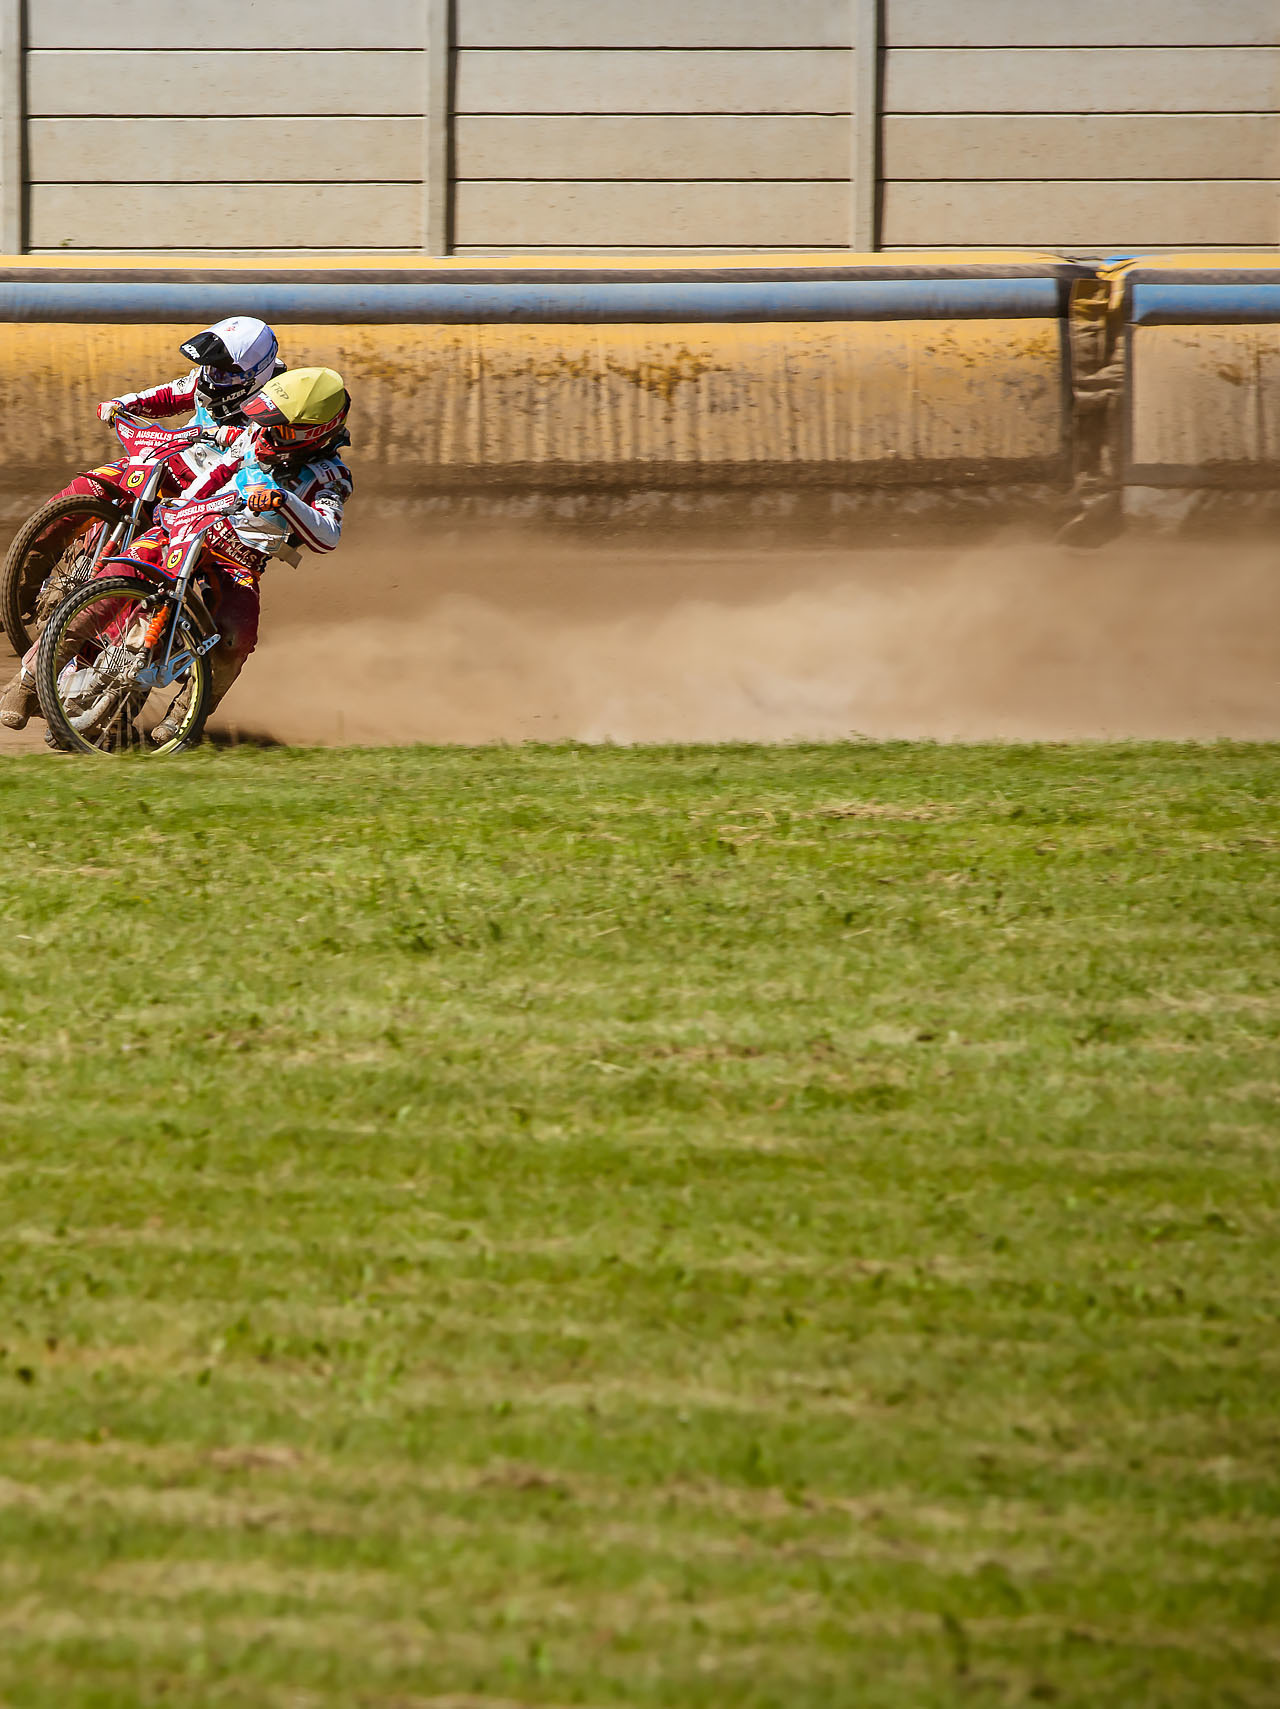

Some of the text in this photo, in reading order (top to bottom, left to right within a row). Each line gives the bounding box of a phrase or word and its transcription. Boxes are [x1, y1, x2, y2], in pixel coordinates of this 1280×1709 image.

[222, 389, 247, 403] LAZER
[136, 430, 173, 441] AUSEKLIS
[213, 521, 258, 566] SEKLIS
